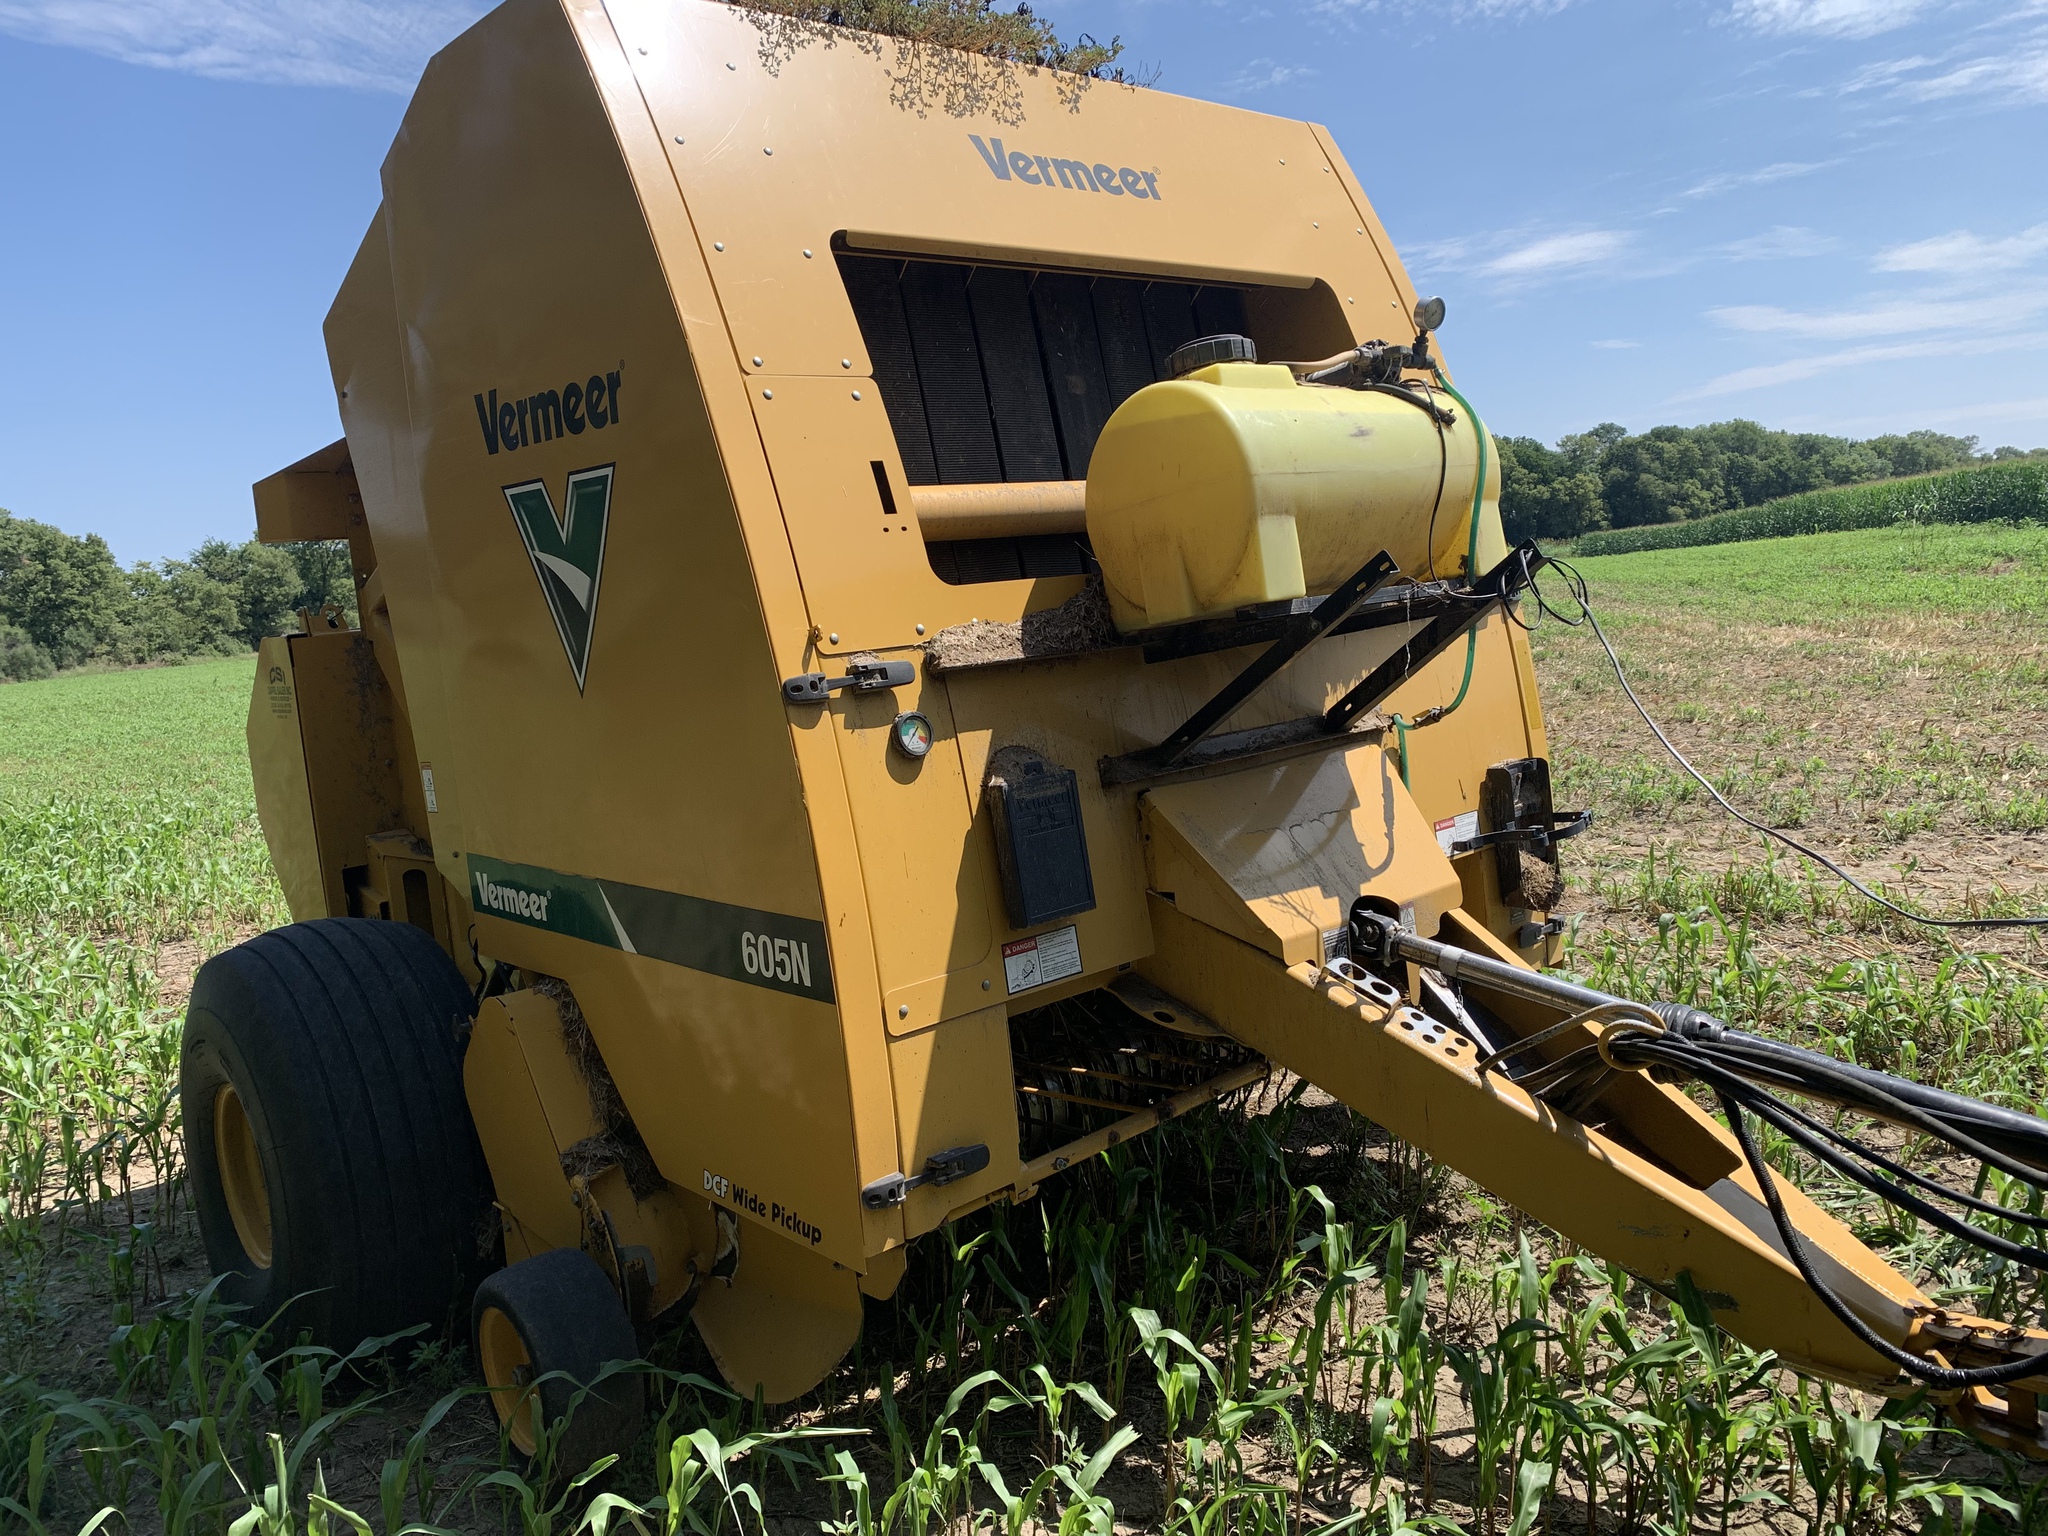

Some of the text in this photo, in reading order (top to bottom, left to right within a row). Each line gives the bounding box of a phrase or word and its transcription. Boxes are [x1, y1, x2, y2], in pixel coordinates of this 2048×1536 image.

[967, 134, 1162, 201] Vermeer
[474, 369, 621, 455] Vermeer
[475, 871, 548, 922] Vermeer
[741, 931, 812, 987] 605N
[1012, 940, 1036, 953] DANGER
[703, 1168, 822, 1246] DCF Wide Pickup
